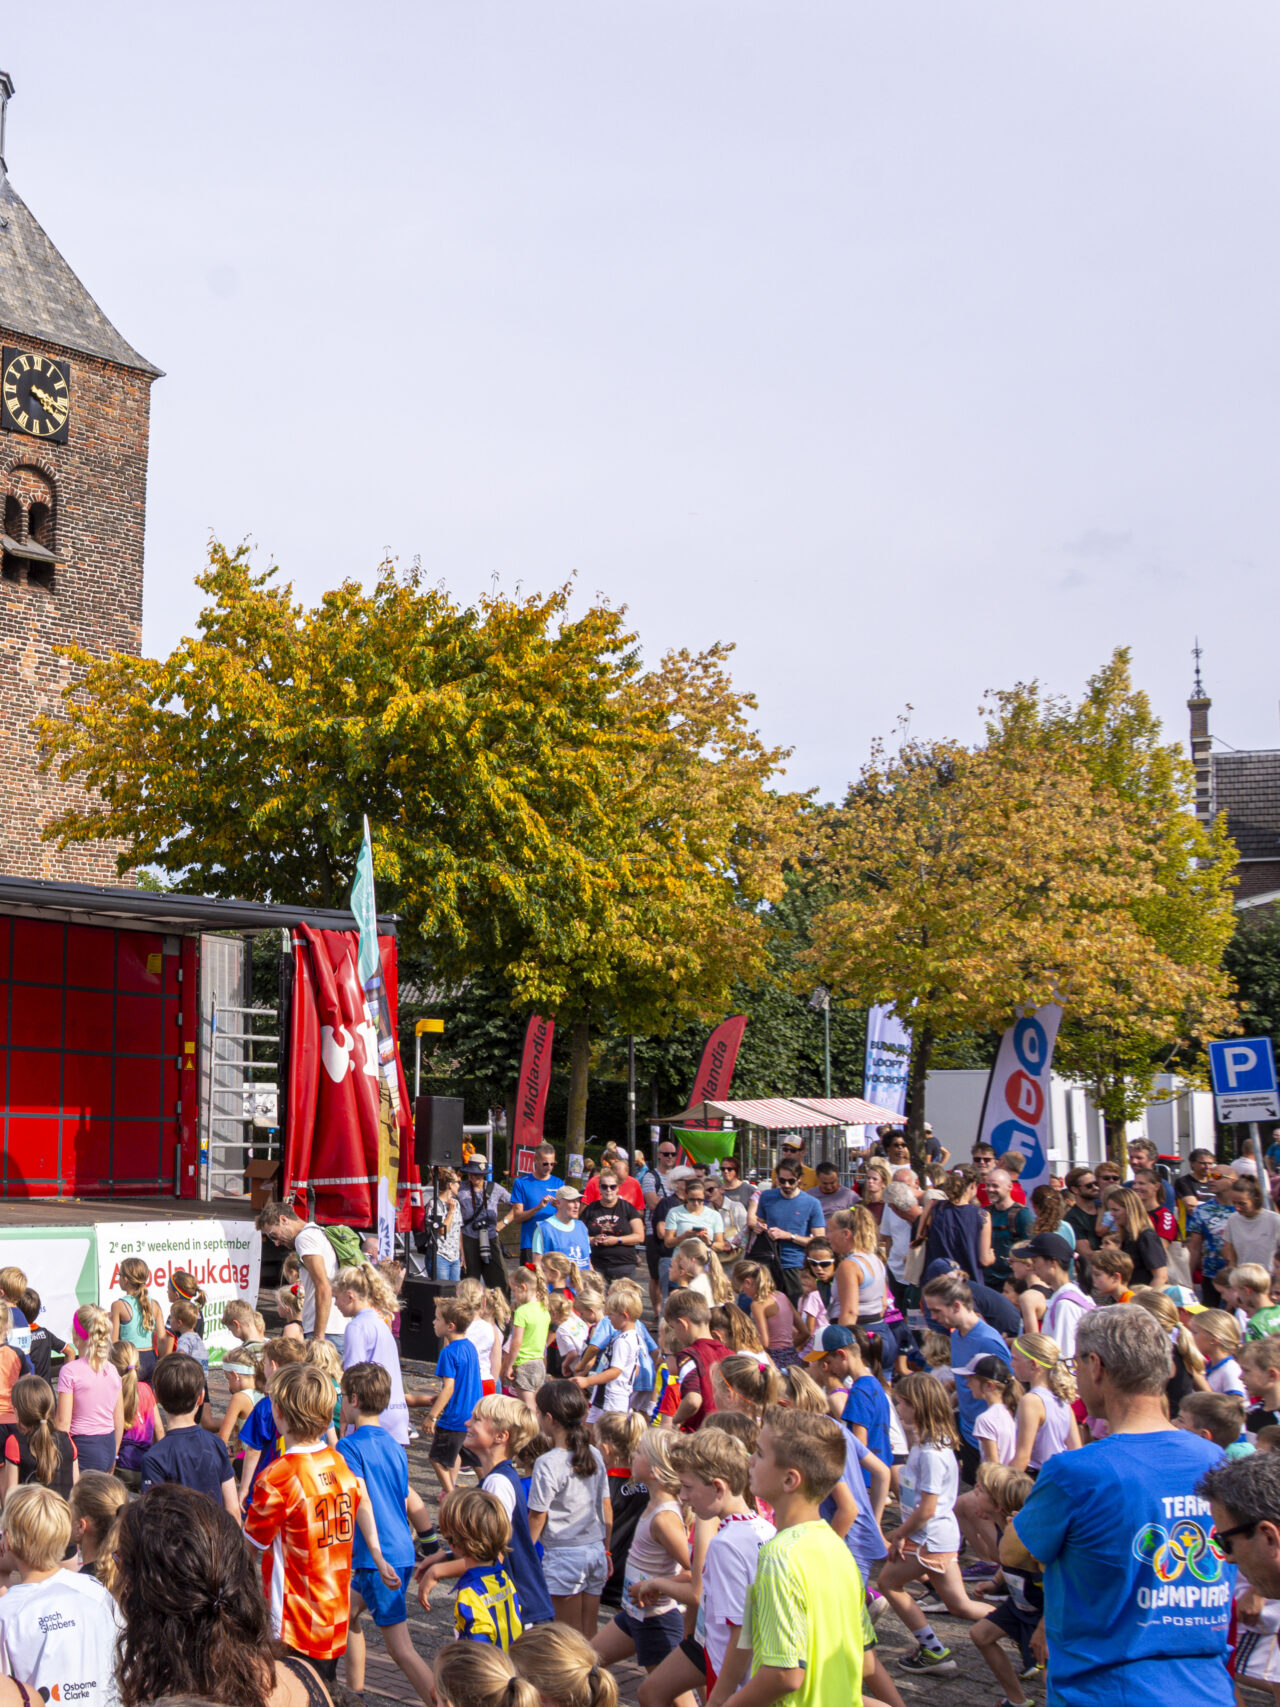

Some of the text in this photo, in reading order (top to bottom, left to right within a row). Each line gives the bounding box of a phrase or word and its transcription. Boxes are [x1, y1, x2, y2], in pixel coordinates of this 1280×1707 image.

[873, 1058, 904, 1068] LOOPT
[1223, 1047, 1257, 1087] P
[522, 1023, 547, 1123] Midlandia
[121, 1242, 133, 1252] en
[148, 1238, 190, 1252] weekend
[193, 1238, 201, 1250] in
[203, 1237, 251, 1251] september
[109, 1258, 250, 1290] Aellukdag
[1161, 1495, 1211, 1519] TEAM
[315, 1493, 353, 1548] 16
[1162, 1614, 1227, 1626] POSTILLIO
[63, 1680, 97, 1692] Osborne
[64, 1690, 90, 1701] Clarke
